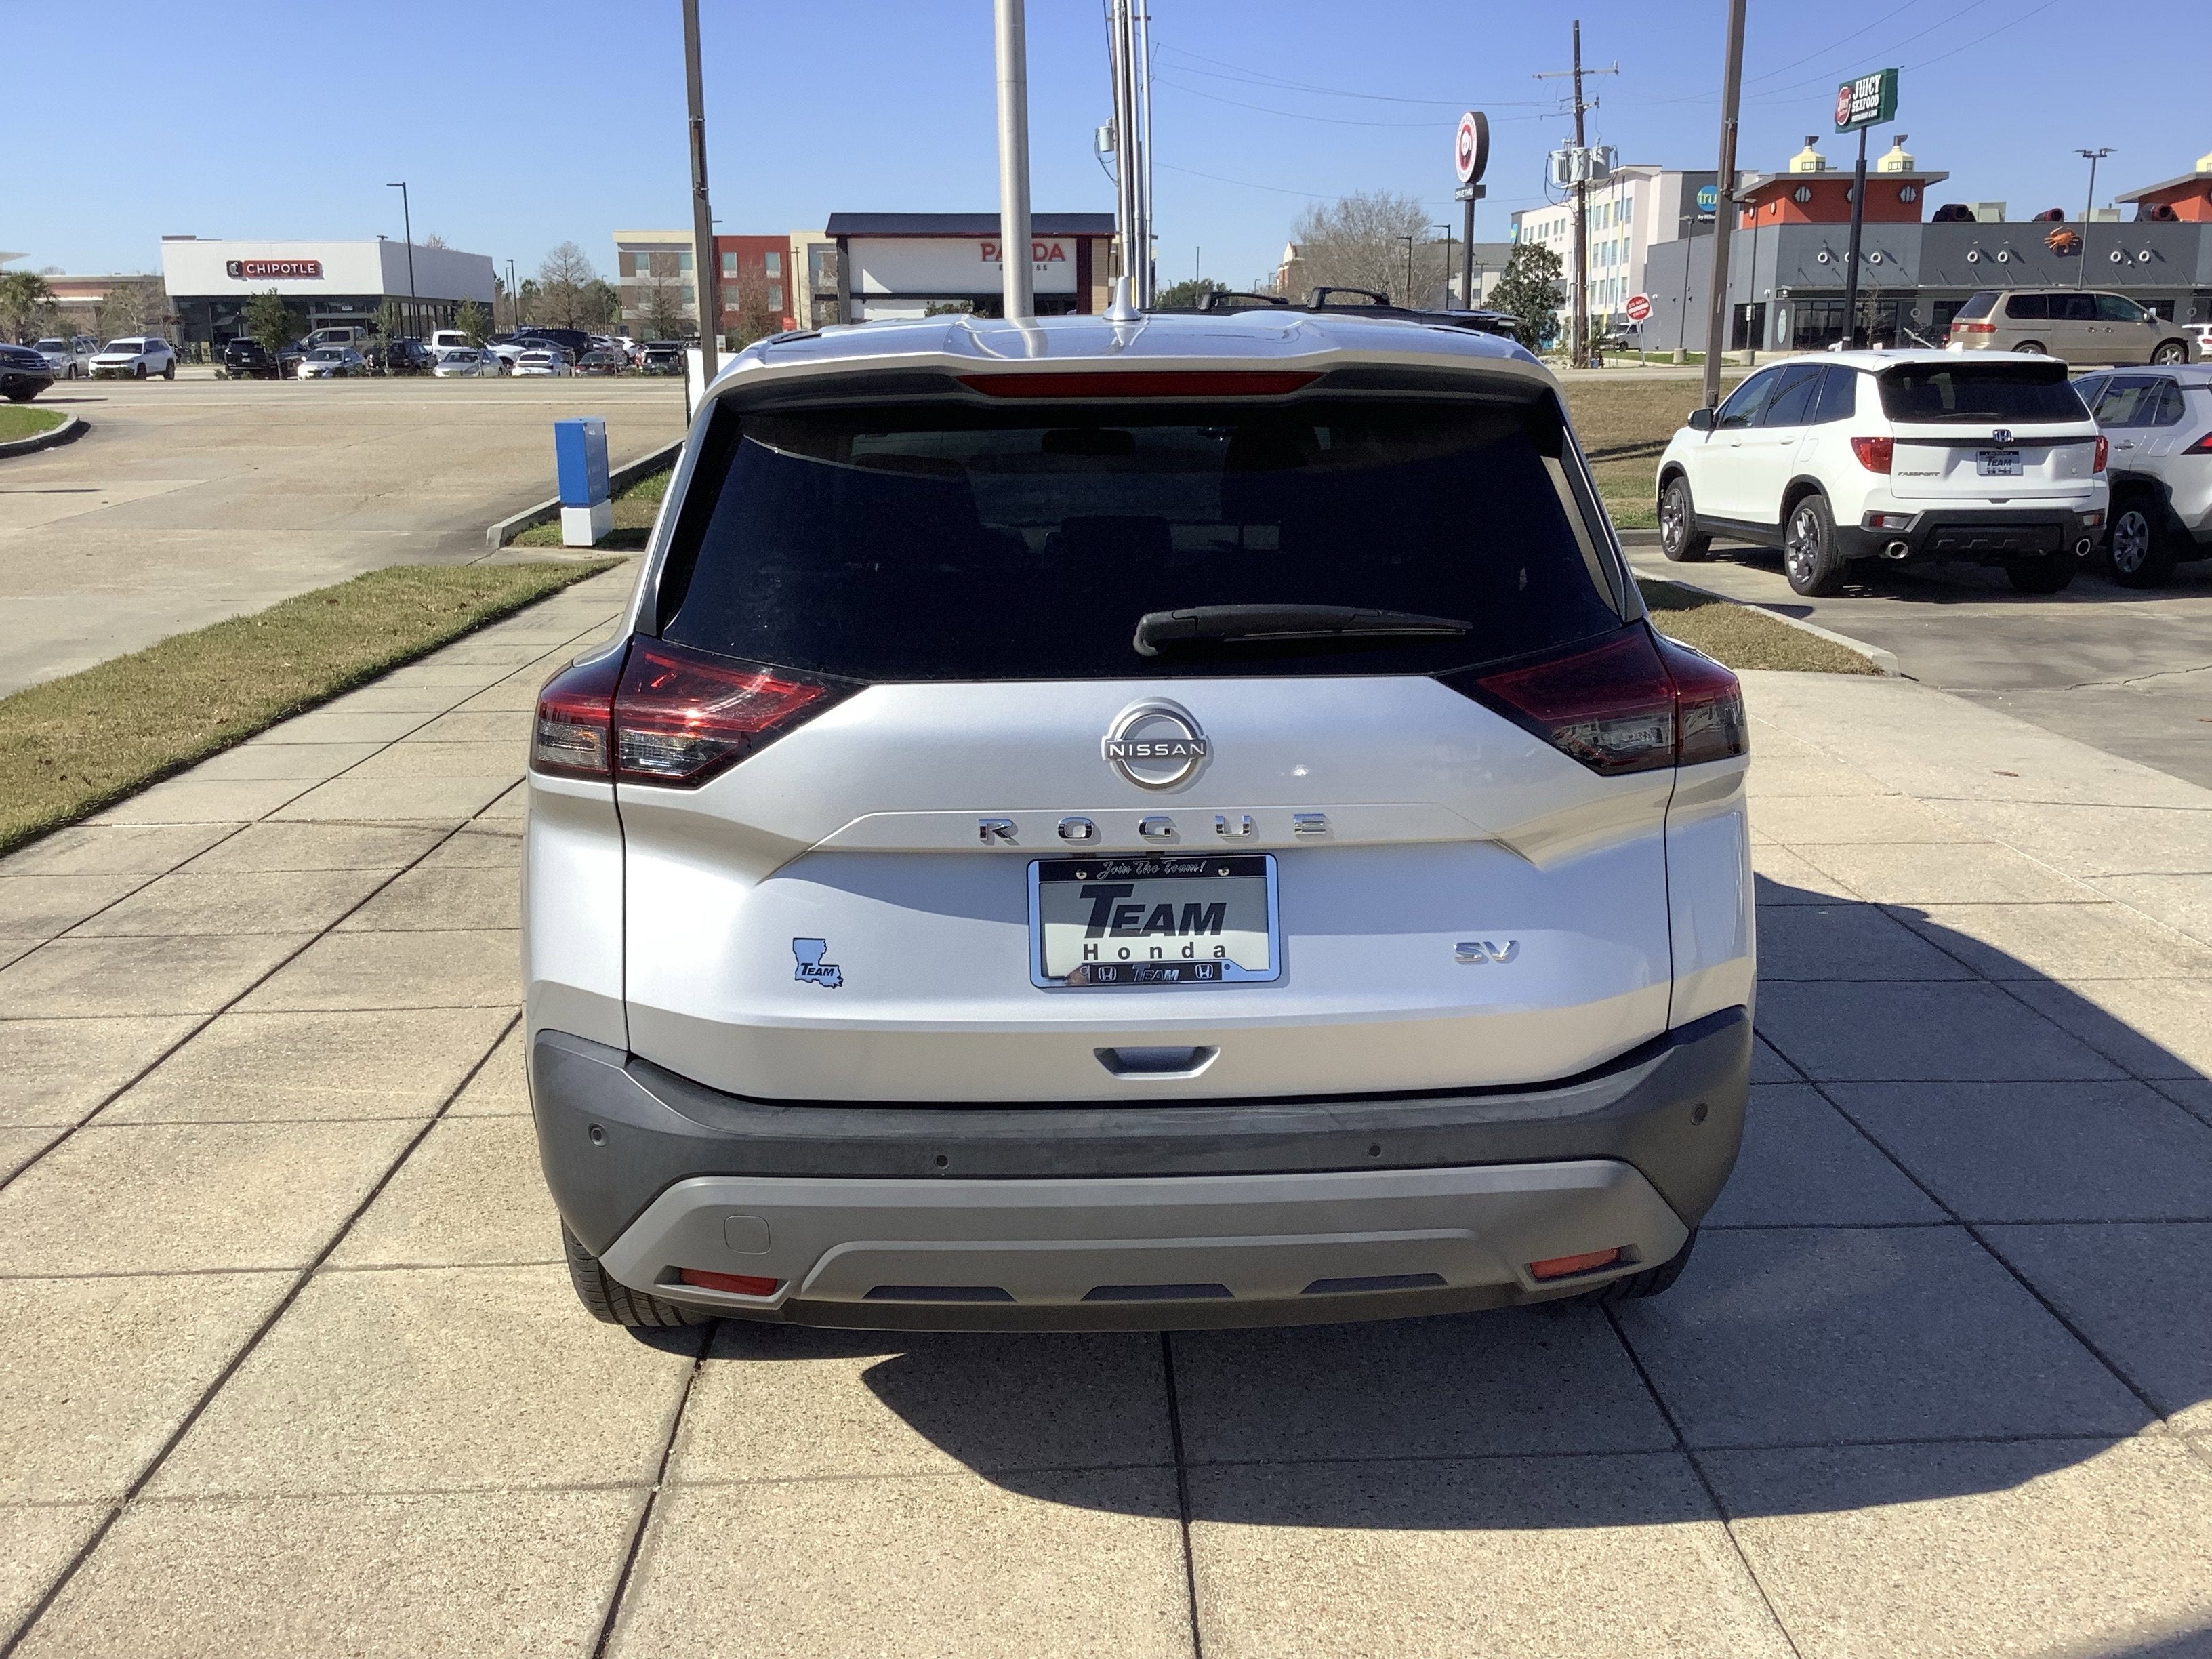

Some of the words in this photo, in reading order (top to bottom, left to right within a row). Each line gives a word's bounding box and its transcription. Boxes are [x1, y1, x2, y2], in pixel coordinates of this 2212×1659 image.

[1852, 74, 1881, 100] JUICY
[1851, 94, 1879, 113] SEAFOOD
[247, 264, 316, 274] CHIPOTLE
[1109, 742, 1204, 756] NISSAN
[977, 813, 1328, 842] ROGUE
[1096, 861, 1132, 880] Join
[1133, 860, 1160, 875] The
[1161, 859, 1207, 874] Team!
[1080, 883, 1227, 939] TEAM
[1084, 942, 1227, 961] Honda
[1454, 940, 1517, 963] SV
[800, 962, 835, 977] TEAM
[1132, 964, 1180, 981] TEAM
